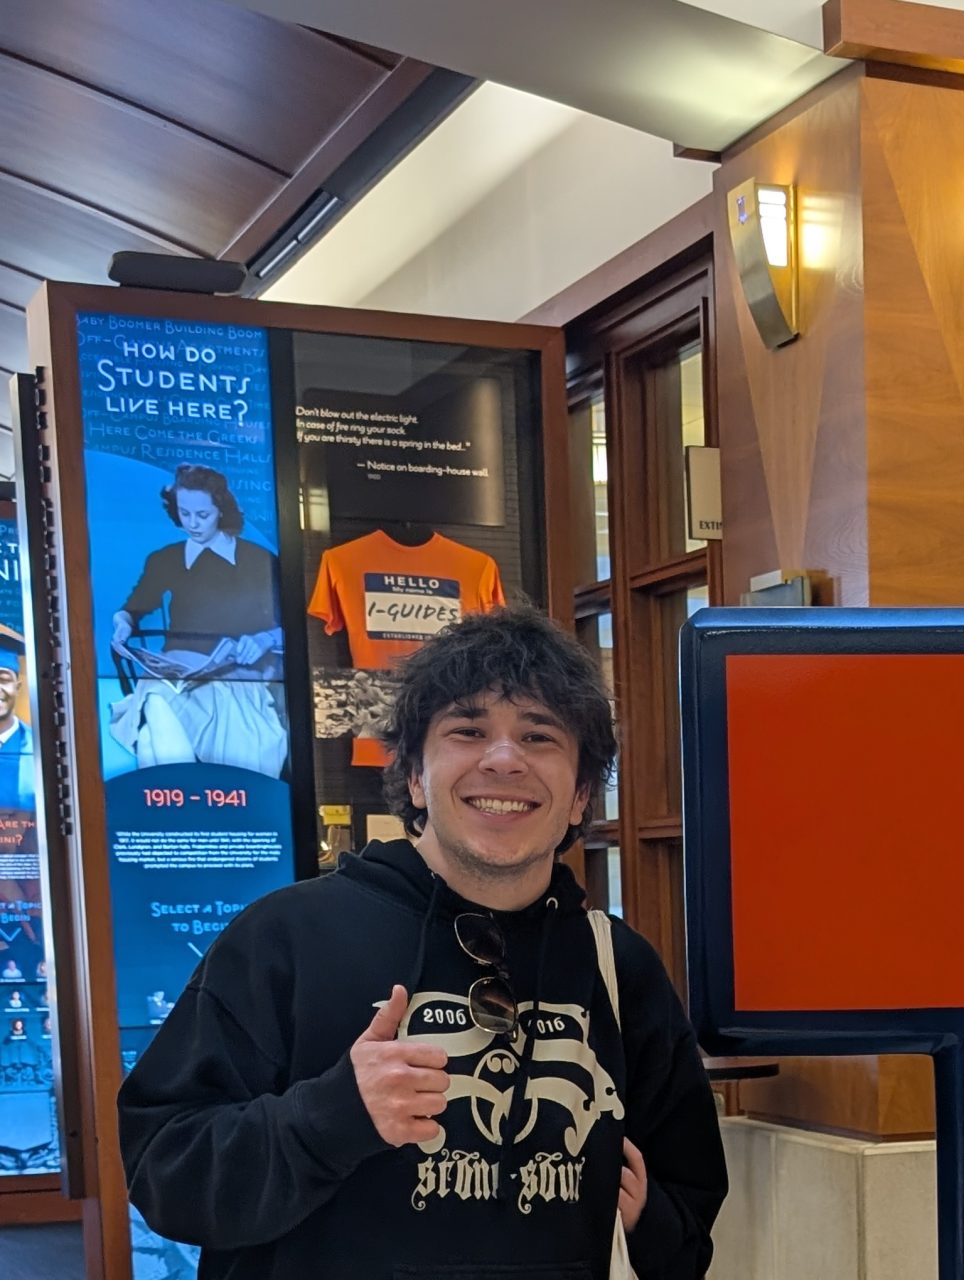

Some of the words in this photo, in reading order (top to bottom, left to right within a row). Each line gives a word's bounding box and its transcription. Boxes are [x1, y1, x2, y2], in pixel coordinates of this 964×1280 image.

[109, 314, 160, 330] BOOMER
[165, 320, 224, 336] BUILDING
[228, 326, 262, 340] BOOM
[123, 342, 175, 361] HOW
[185, 346, 216, 364] DO
[97, 359, 251, 394] STUDENTS
[106, 396, 159, 415] LIVE
[168, 399, 249, 427] HERE?
[320, 408, 339, 419] blow
[341, 411, 354, 420] out
[356, 410, 369, 420] the
[370, 413, 398, 423] electric
[89, 423, 130, 438] HERE
[135, 425, 175, 441] COME
[178, 430, 201, 441] THE
[207, 430, 258, 444] GREEKS
[306, 421, 325, 431] case
[327, 421, 336, 433] of
[335, 421, 349, 433] fire
[350, 423, 365, 435] ring
[366, 425, 385, 435] your
[304, 433, 320, 443] you
[322, 434, 335, 442] are
[336, 434, 361, 446] thirsty
[362, 436, 383, 446] there
[384, 437, 391, 446] is
[391, 439, 397, 447] a
[398, 439, 422, 450] spring
[423, 439, 432, 449] in
[432, 440, 445, 450] the
[141, 443, 220, 461] RESIDENCE
[225, 448, 271, 464] HALLS
[367, 460, 395, 471] Notice
[397, 463, 408, 472] on
[408, 463, 471, 476] boarding-house
[384, 575, 440, 589] HELLO
[368, 601, 458, 622] I-GUIDES
[143, 788, 184, 807] 1919
[204, 789, 247, 807] 1941
[150, 901, 200, 917] SELECT
[202, 904, 212, 913] A
[171, 922, 190, 932] TO
[423, 1007, 467, 1025] 2006
[528, 1016, 566, 1034] 016
